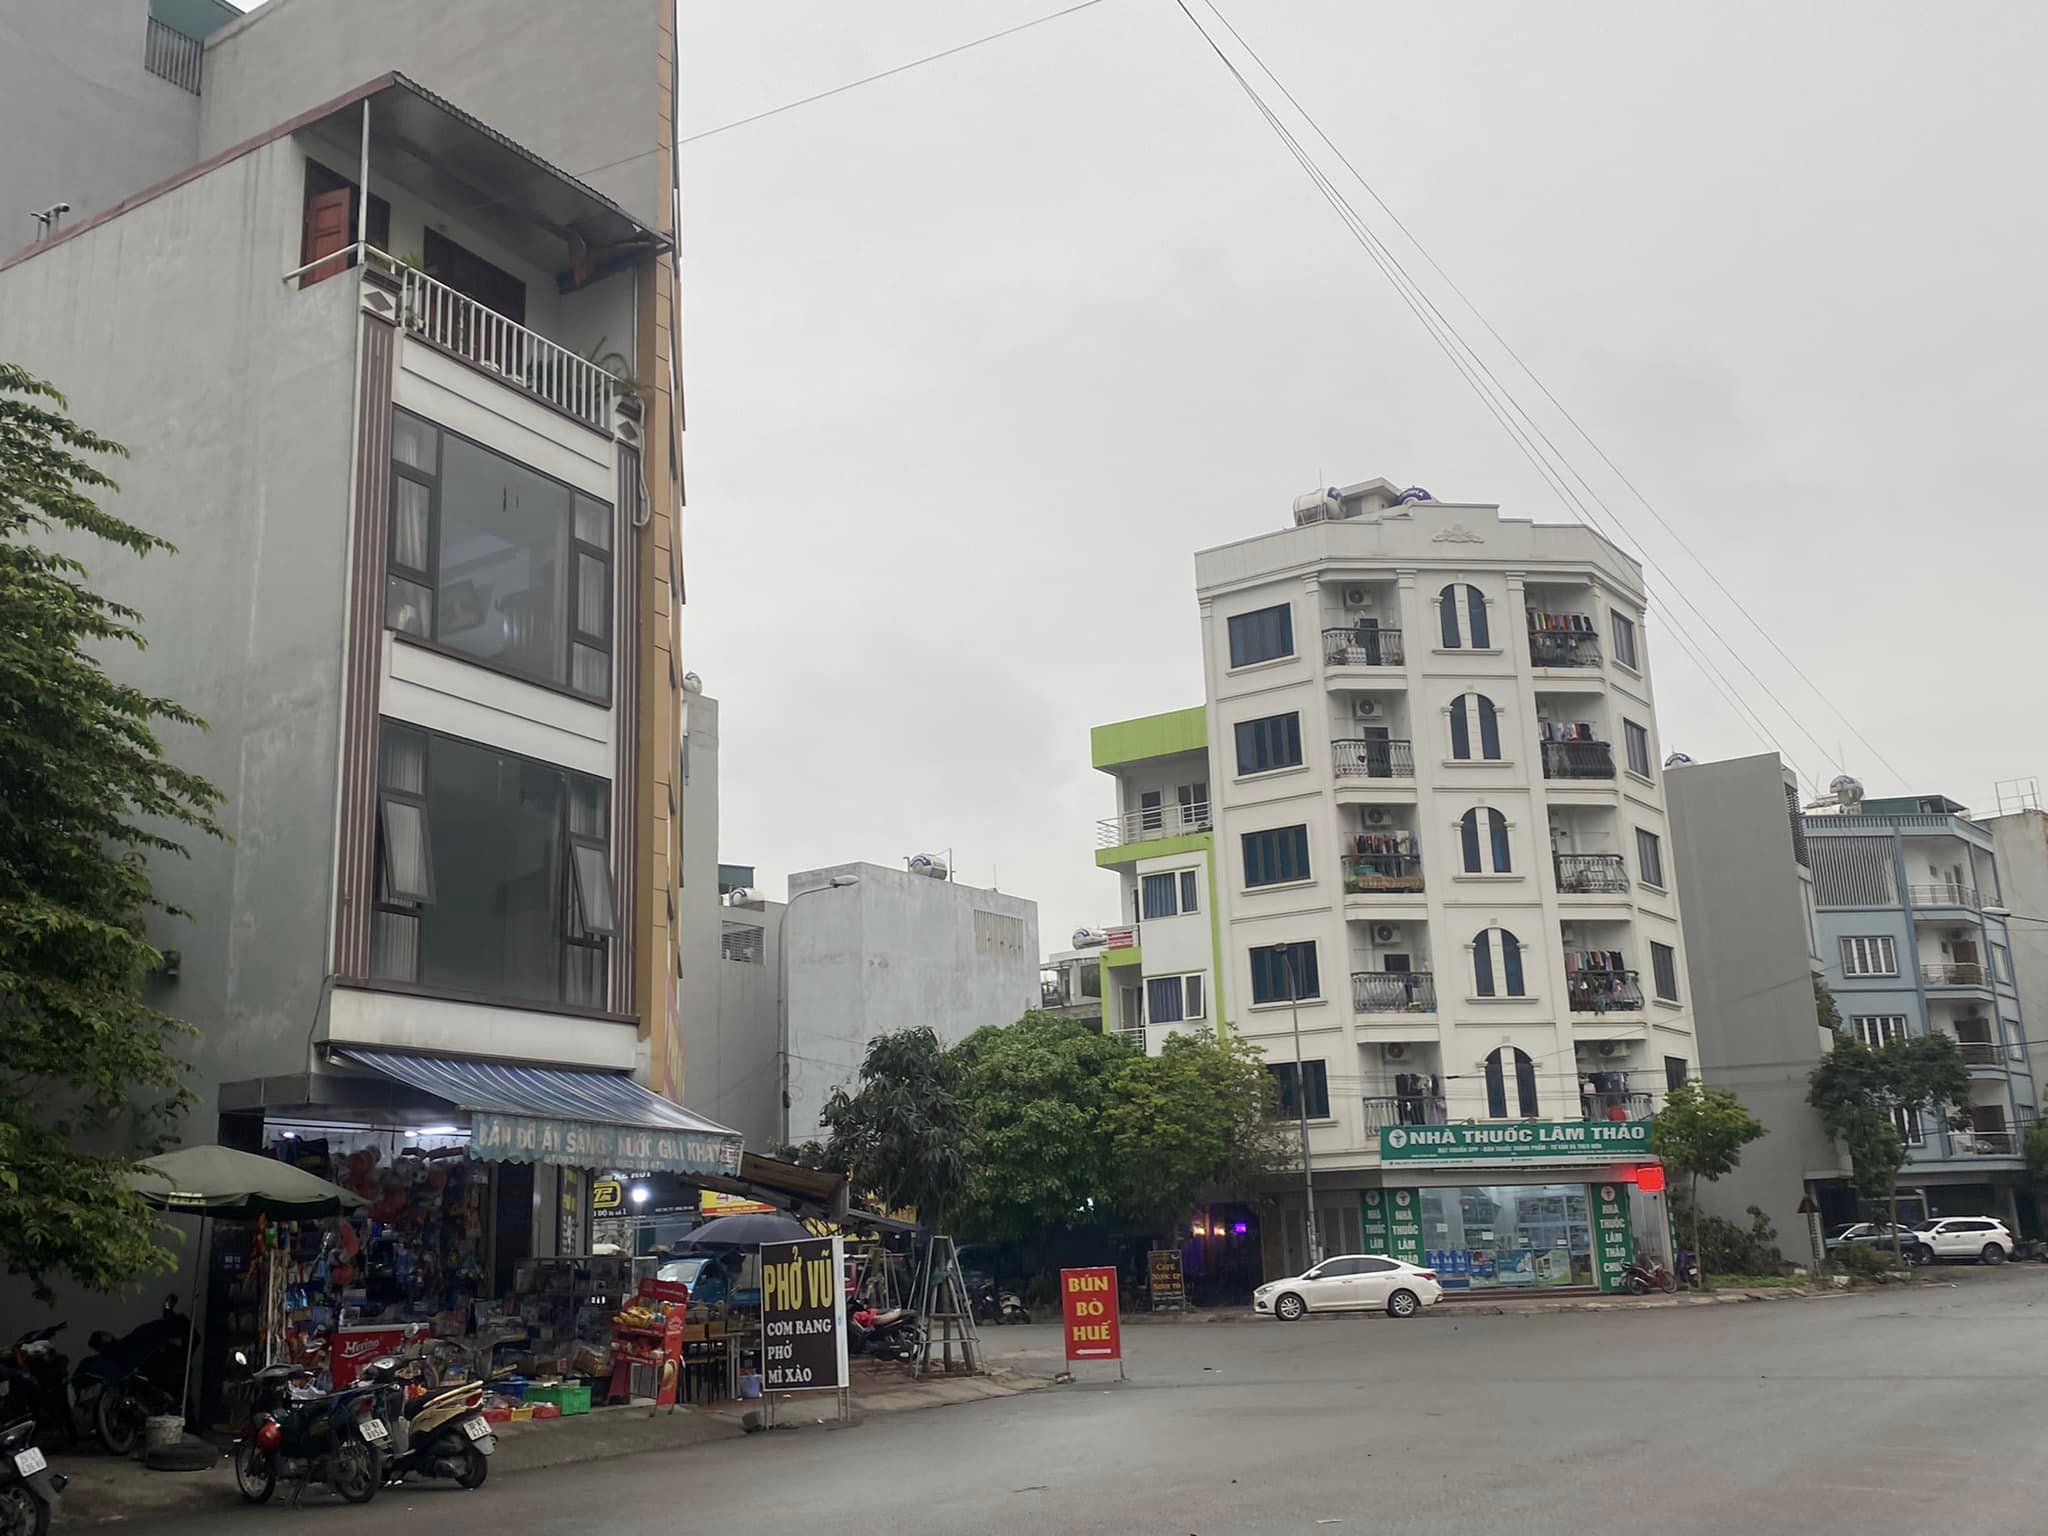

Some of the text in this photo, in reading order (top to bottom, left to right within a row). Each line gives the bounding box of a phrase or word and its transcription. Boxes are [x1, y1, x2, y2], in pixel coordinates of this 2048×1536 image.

[1410, 1123, 1645, 1145] NHÀ THUỐC LÂM THẢO
[1395, 1208, 1413, 1220] NHÀ
[1602, 1204, 1619, 1214] NHÀ
[1392, 1222, 1419, 1235] THUỐC
[1600, 1216, 1625, 1229] THUỐC
[1397, 1237, 1416, 1250] LÂM
[1605, 1231, 1623, 1243] LÂM
[764, 1246, 833, 1311] PHỞ VŨ
[1068, 1274, 1109, 1293] BÚN
[1075, 1298, 1105, 1317] BÒ
[767, 1319, 832, 1337] CƠM RANG
[1072, 1320, 1112, 1341] HUẾ
[343, 1338, 380, 1353] Merino
[767, 1340, 793, 1360] PHỞ
[768, 1365, 812, 1383] MÌ XÀO
